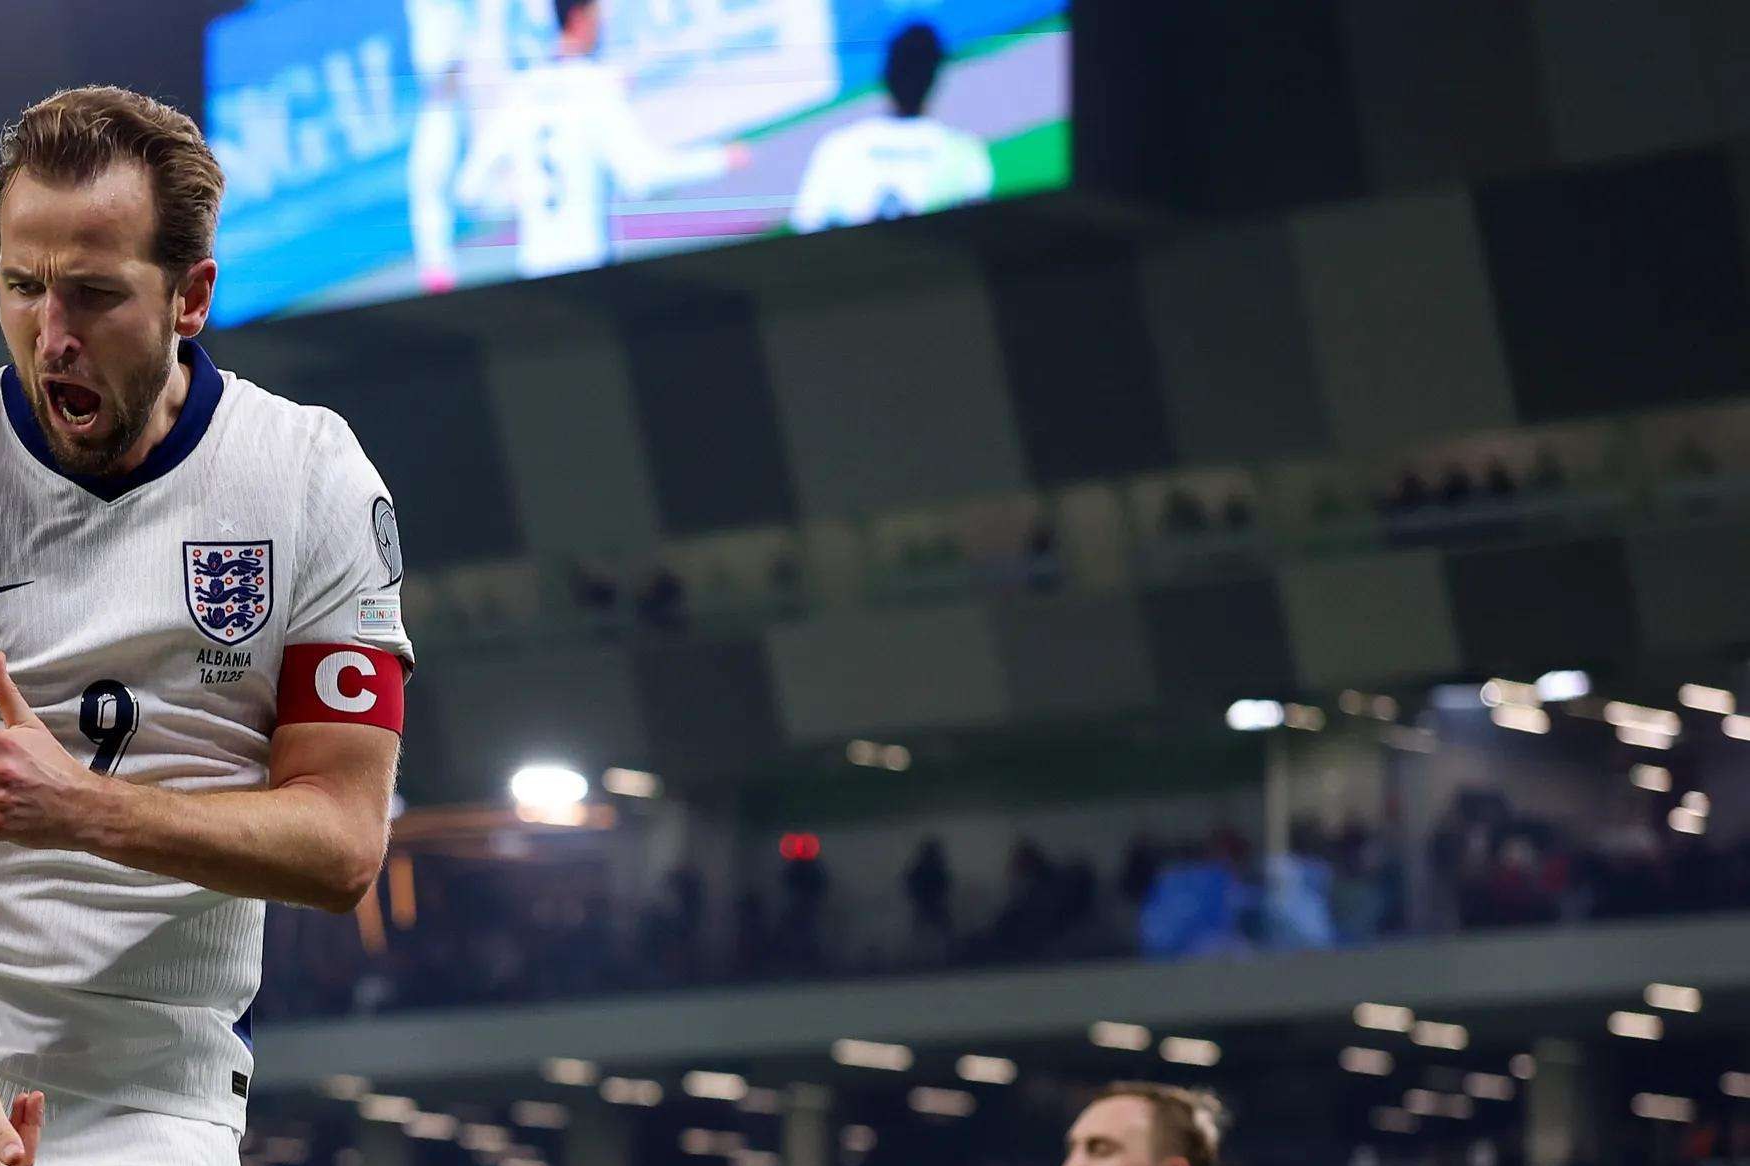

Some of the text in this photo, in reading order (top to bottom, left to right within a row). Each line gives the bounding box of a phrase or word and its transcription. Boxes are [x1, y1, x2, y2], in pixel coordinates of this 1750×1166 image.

[196, 648, 251, 667] ALBANIA
[200, 668, 244, 684] 16.11.25
[315, 650, 378, 714] C
[79, 679, 139, 777] 9
